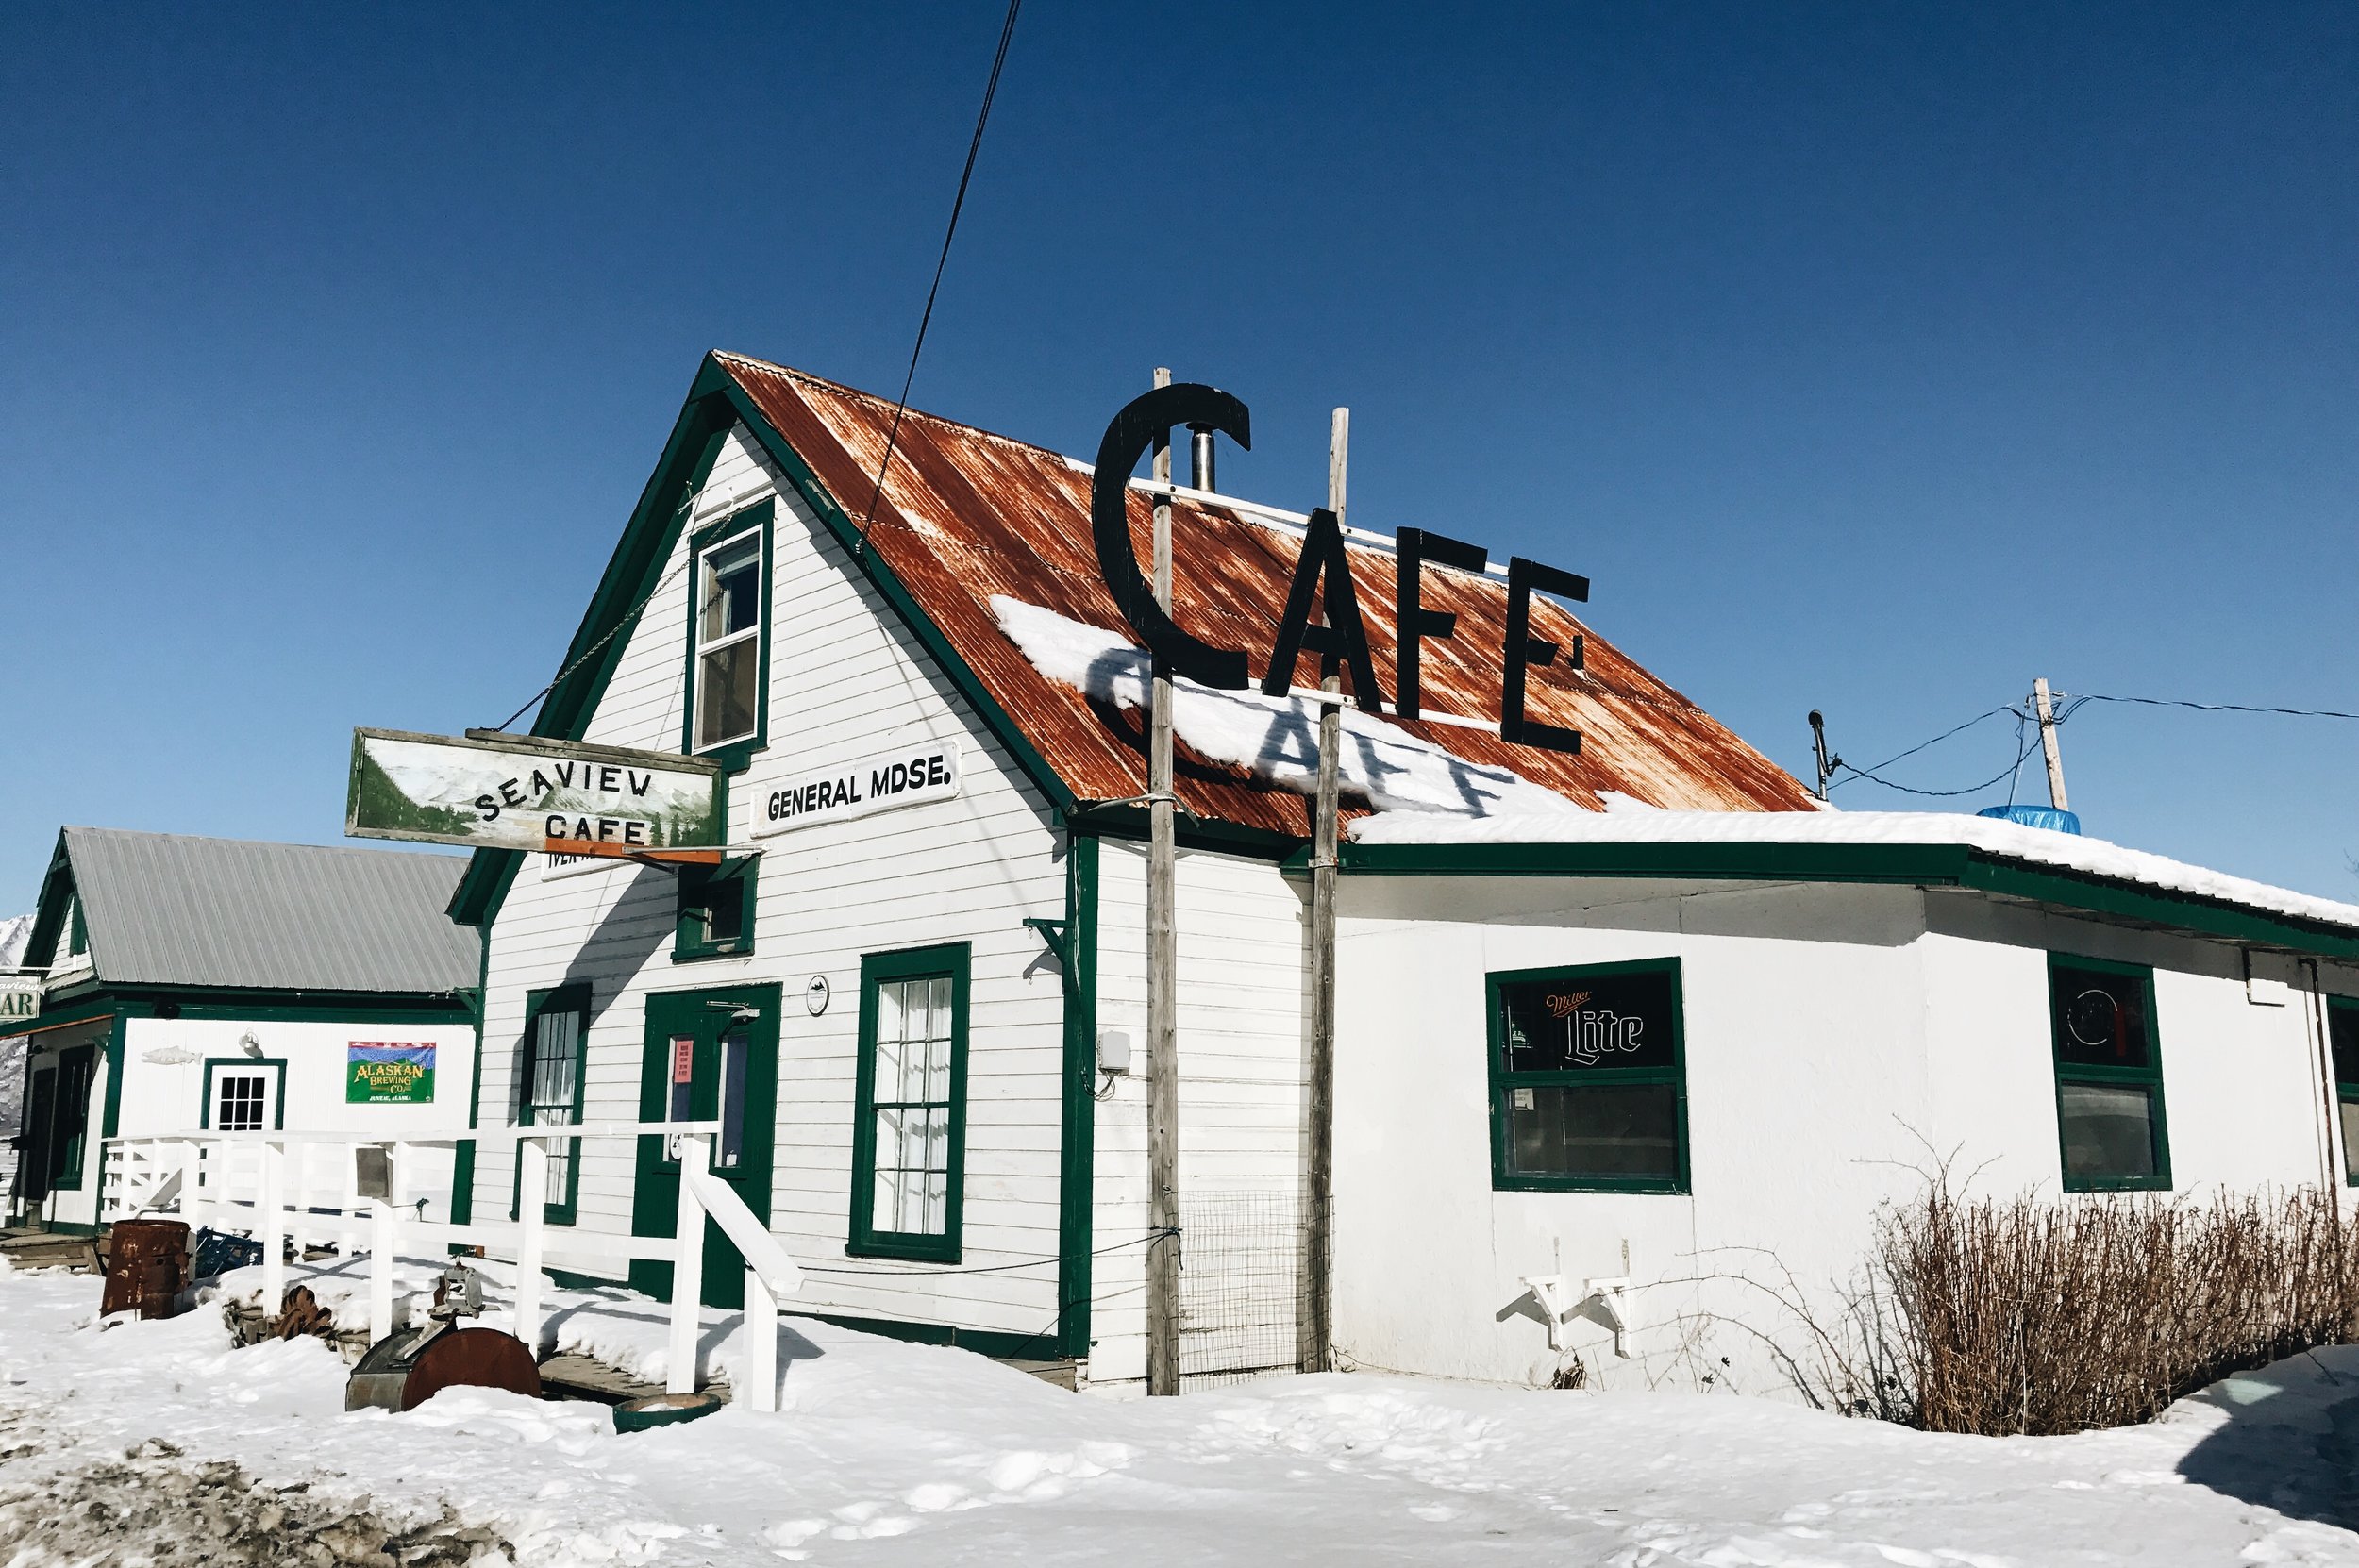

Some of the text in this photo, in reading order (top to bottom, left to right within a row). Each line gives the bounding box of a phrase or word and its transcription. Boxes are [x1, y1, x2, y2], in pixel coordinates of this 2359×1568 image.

[1092, 382, 1590, 755] CAFE
[475, 761, 651, 822] SEAVIEW
[768, 755, 952, 821] GENERAL MDSE.
[545, 814, 645, 845] CAFE
[0, 981, 38, 991] aview
[0, 993, 34, 1015] AR
[1546, 991, 1592, 1013] Miller
[1565, 1010, 1644, 1066] Lite
[354, 1065, 425, 1083] ALASKAN
[370, 1076, 411, 1086] BREWING
